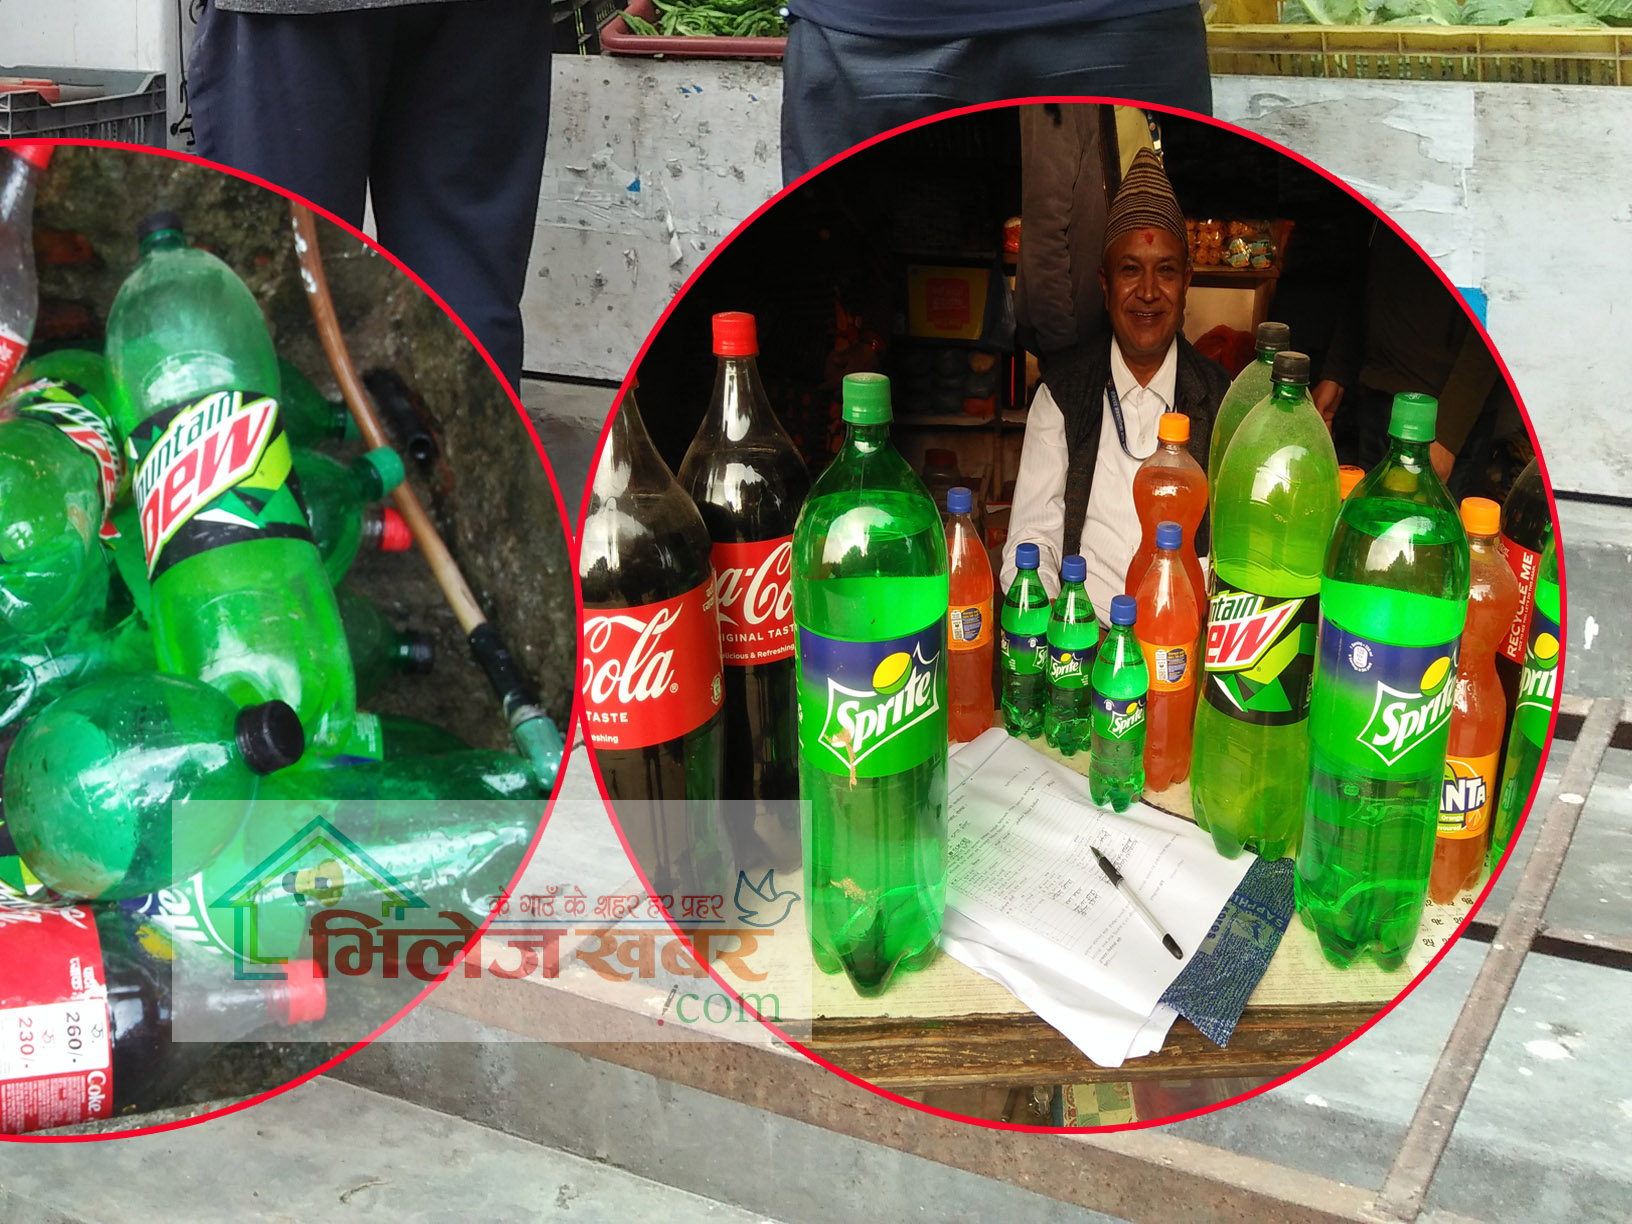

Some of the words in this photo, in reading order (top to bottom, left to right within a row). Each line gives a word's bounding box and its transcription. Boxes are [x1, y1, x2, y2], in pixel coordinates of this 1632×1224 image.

[1520, 551, 1534, 583] ME
[1211, 596, 1259, 622] ntain
[721, 652, 748, 660] elicious
[757, 643, 796, 658] Refreshing
[1051, 657, 1079, 679] Sprite
[831, 666, 932, 753] Sprite
[1112, 707, 1143, 733] Sprite
[87, 1070, 106, 1113] Coke
